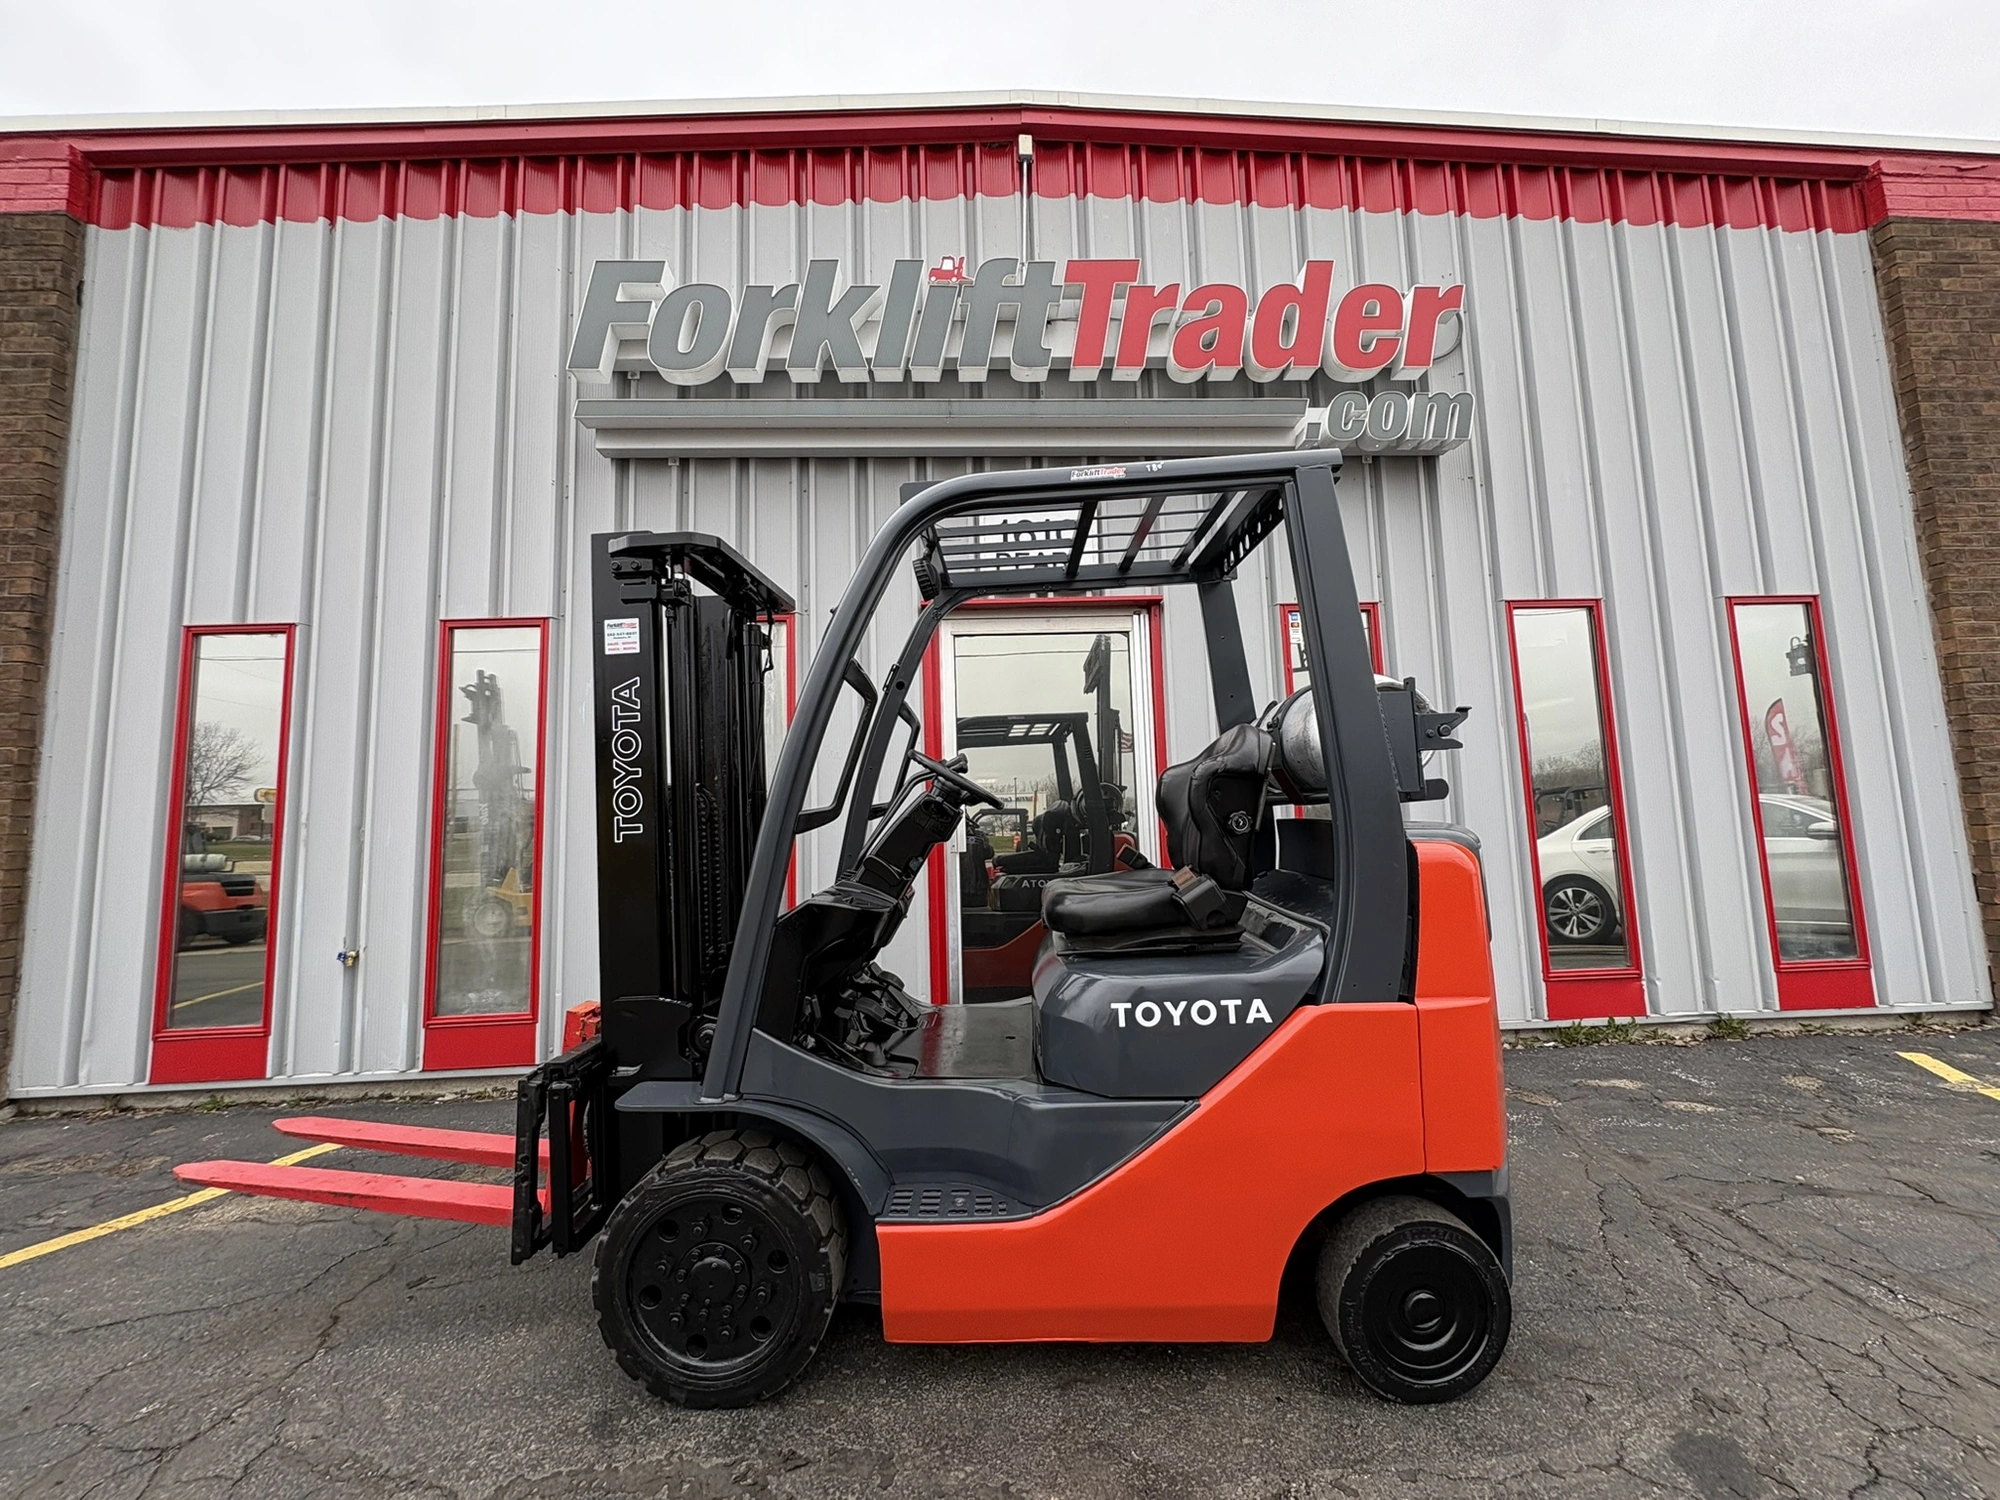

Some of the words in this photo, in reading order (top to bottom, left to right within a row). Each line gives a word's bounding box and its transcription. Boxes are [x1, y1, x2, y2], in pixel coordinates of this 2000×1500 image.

[1305, 391, 1475, 442] .com
[612, 676, 643, 843] TOYOTA
[1110, 998, 1273, 1028] TOYOTA
